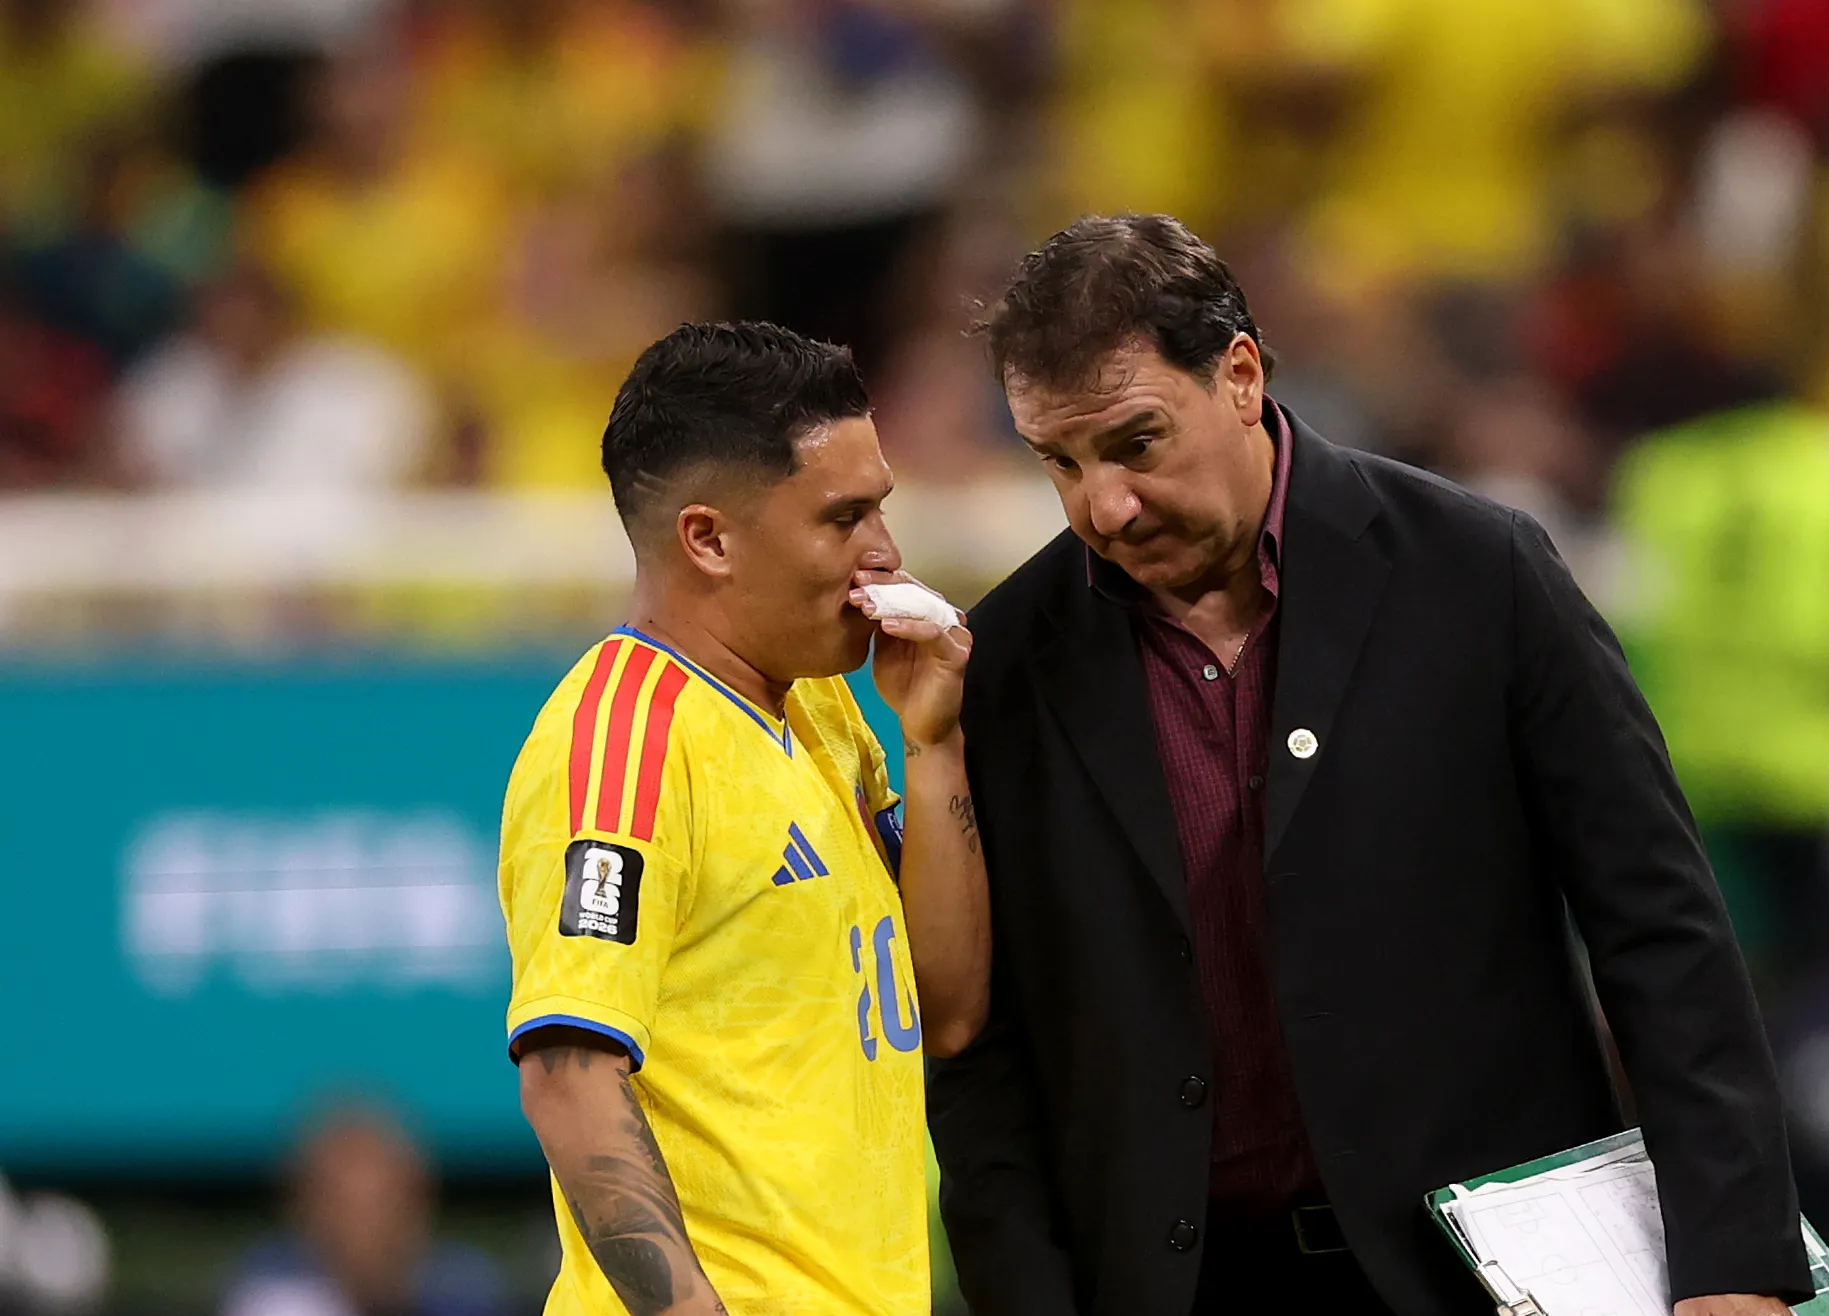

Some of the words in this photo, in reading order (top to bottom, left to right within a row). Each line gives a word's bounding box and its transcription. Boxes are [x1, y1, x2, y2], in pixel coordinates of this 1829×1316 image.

[591, 898, 609, 909] FIFA
[577, 918, 618, 935] 2026
[850, 915, 921, 1061] 20
